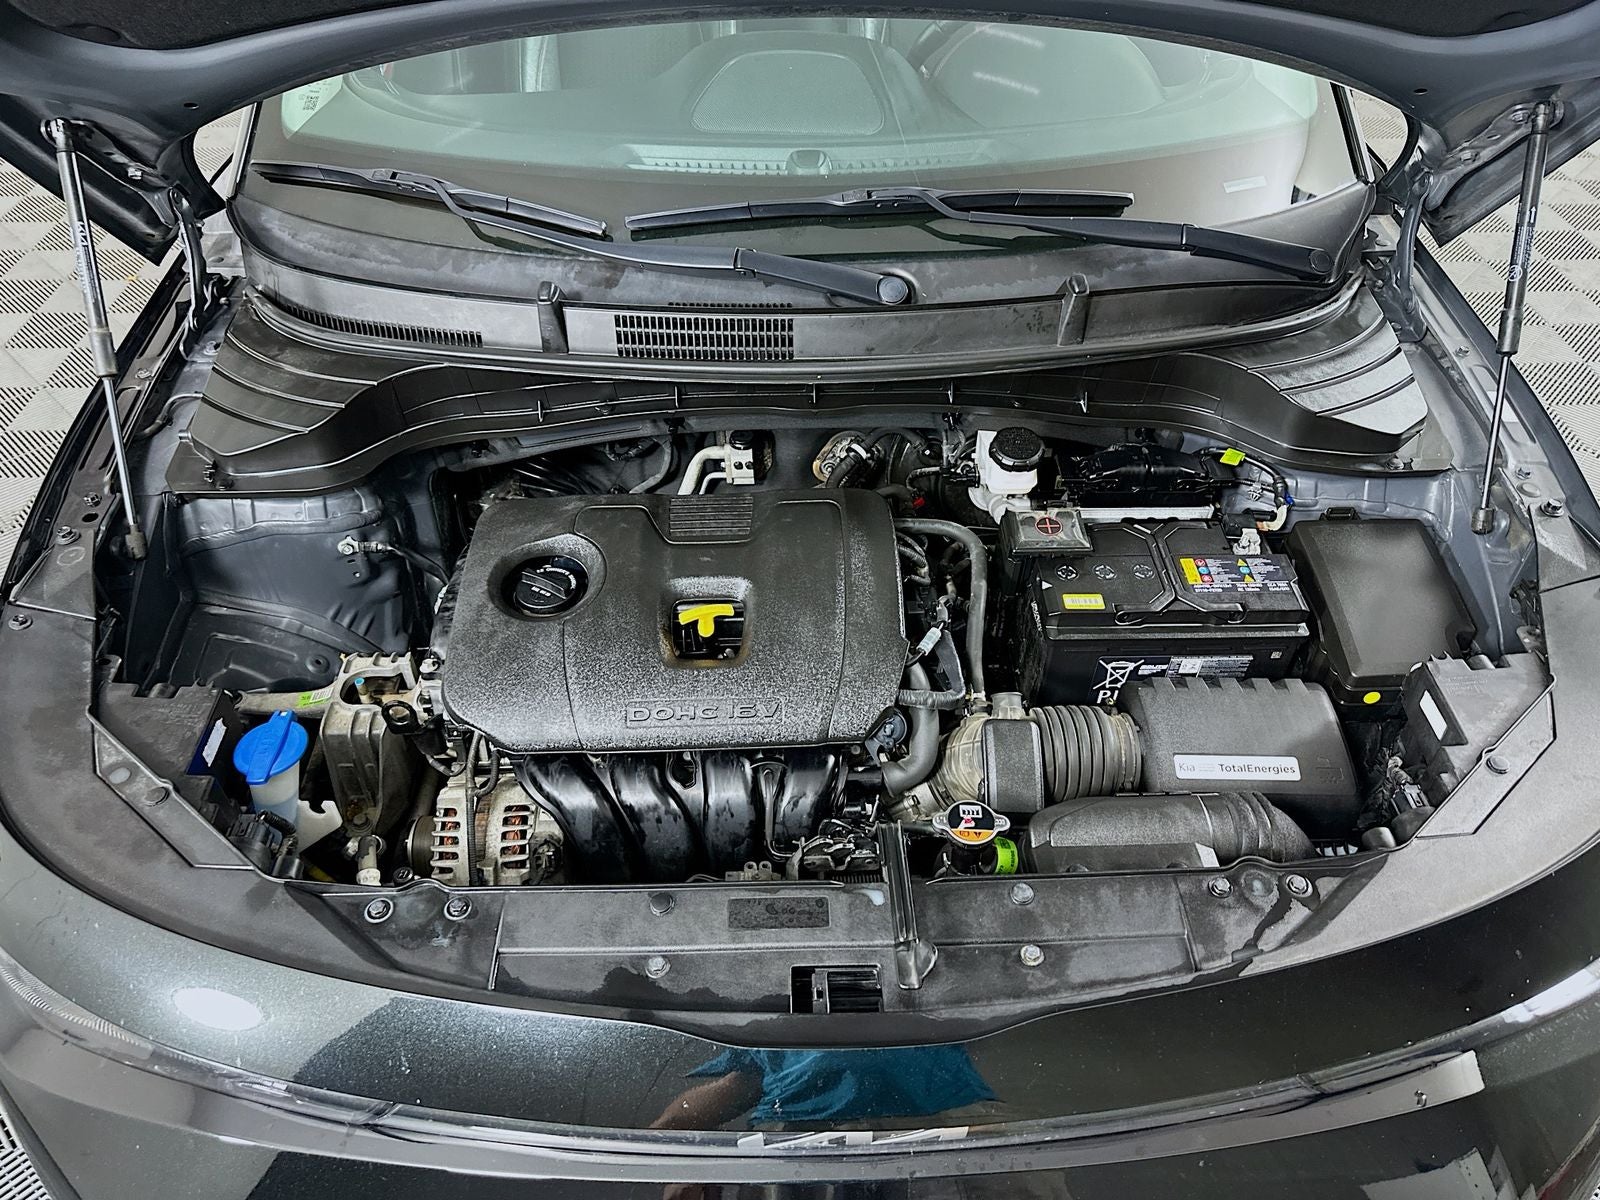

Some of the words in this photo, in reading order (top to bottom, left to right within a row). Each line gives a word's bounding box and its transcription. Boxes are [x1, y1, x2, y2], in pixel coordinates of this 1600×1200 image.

[626, 704, 719, 722] DOHC
[727, 702, 781, 719] 16V
[1178, 762, 1196, 772] Kia
[1218, 763, 1296, 775] TotalEnergies
